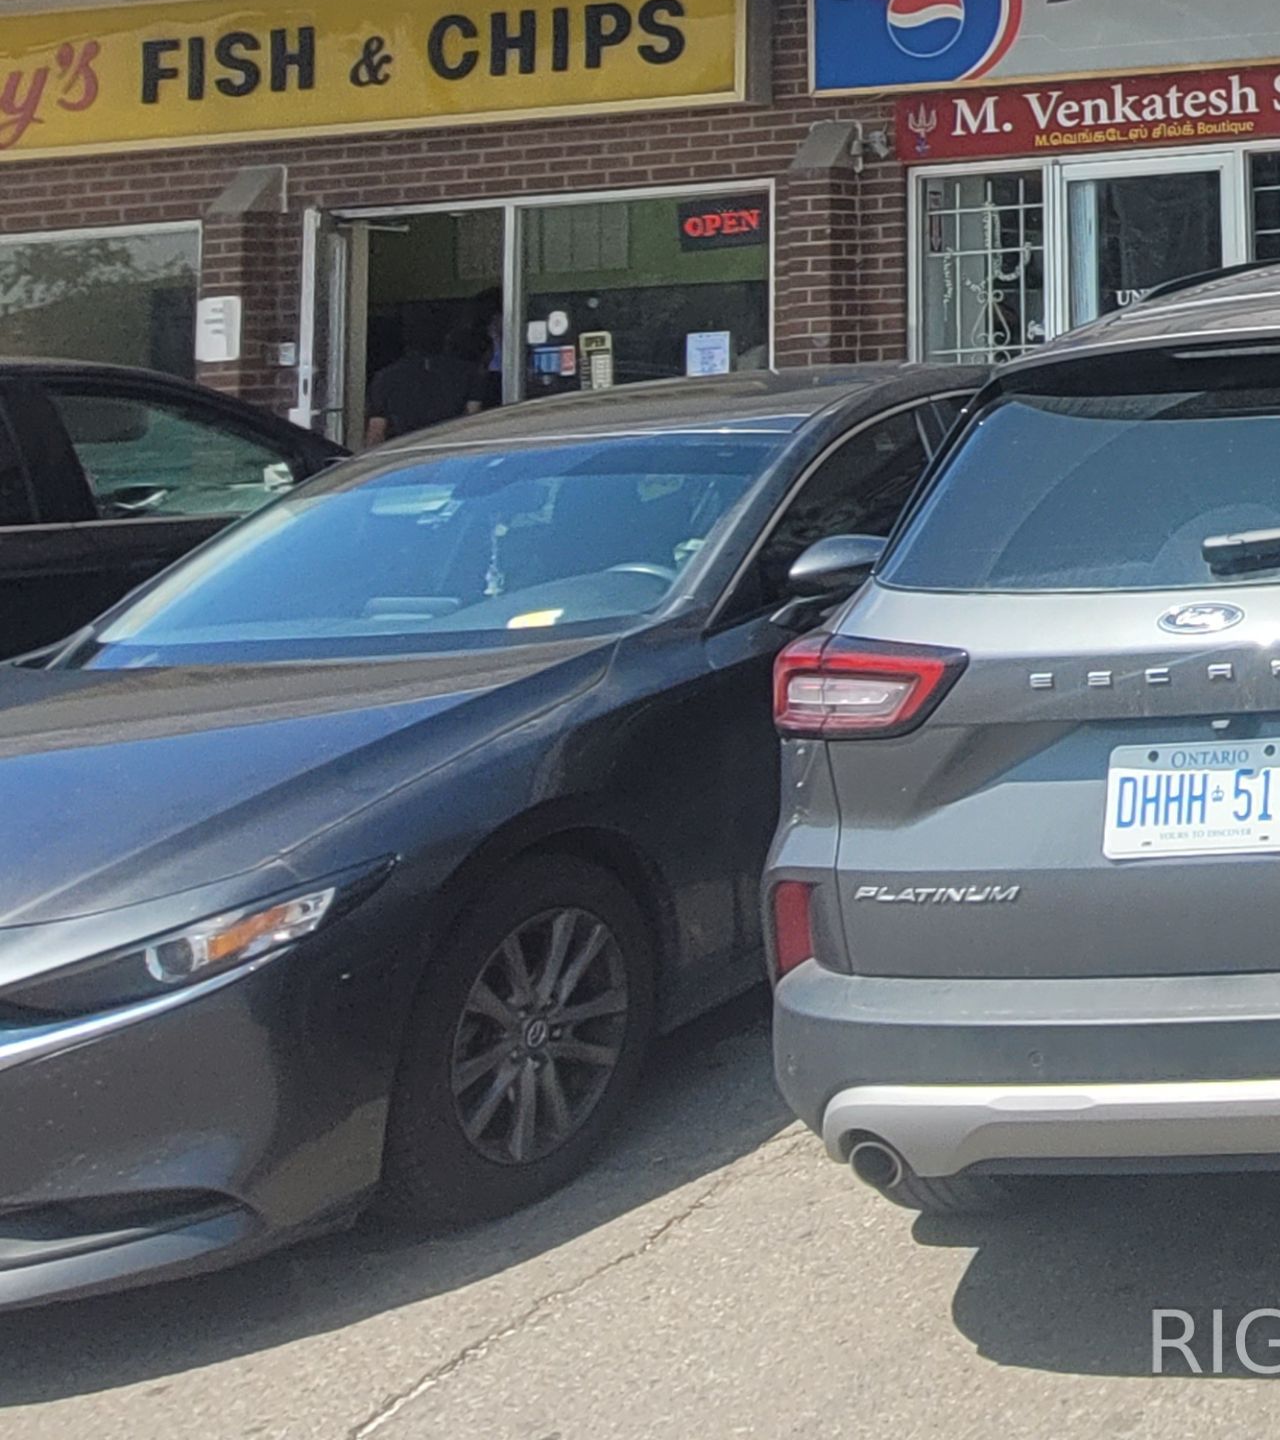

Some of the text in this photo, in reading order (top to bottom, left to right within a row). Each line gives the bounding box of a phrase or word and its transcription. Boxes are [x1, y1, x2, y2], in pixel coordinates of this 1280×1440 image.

[142, 27, 314, 104] FISH
[350, 36, 392, 86] &
[952, 96, 1013, 136] M.
[1023, 74, 1260, 130] Venkatesh
[1197, 120, 1255, 136] Boutique
[684, 210, 761, 237] OPEN
[1171, 749, 1249, 769] ONTARIO
[1116, 773, 1210, 829] DHHH
[1159, 831, 1188, 841] YOURS
[1207, 827, 1252, 838] DISCOVER
[854, 885, 1020, 903] PLATINUM
